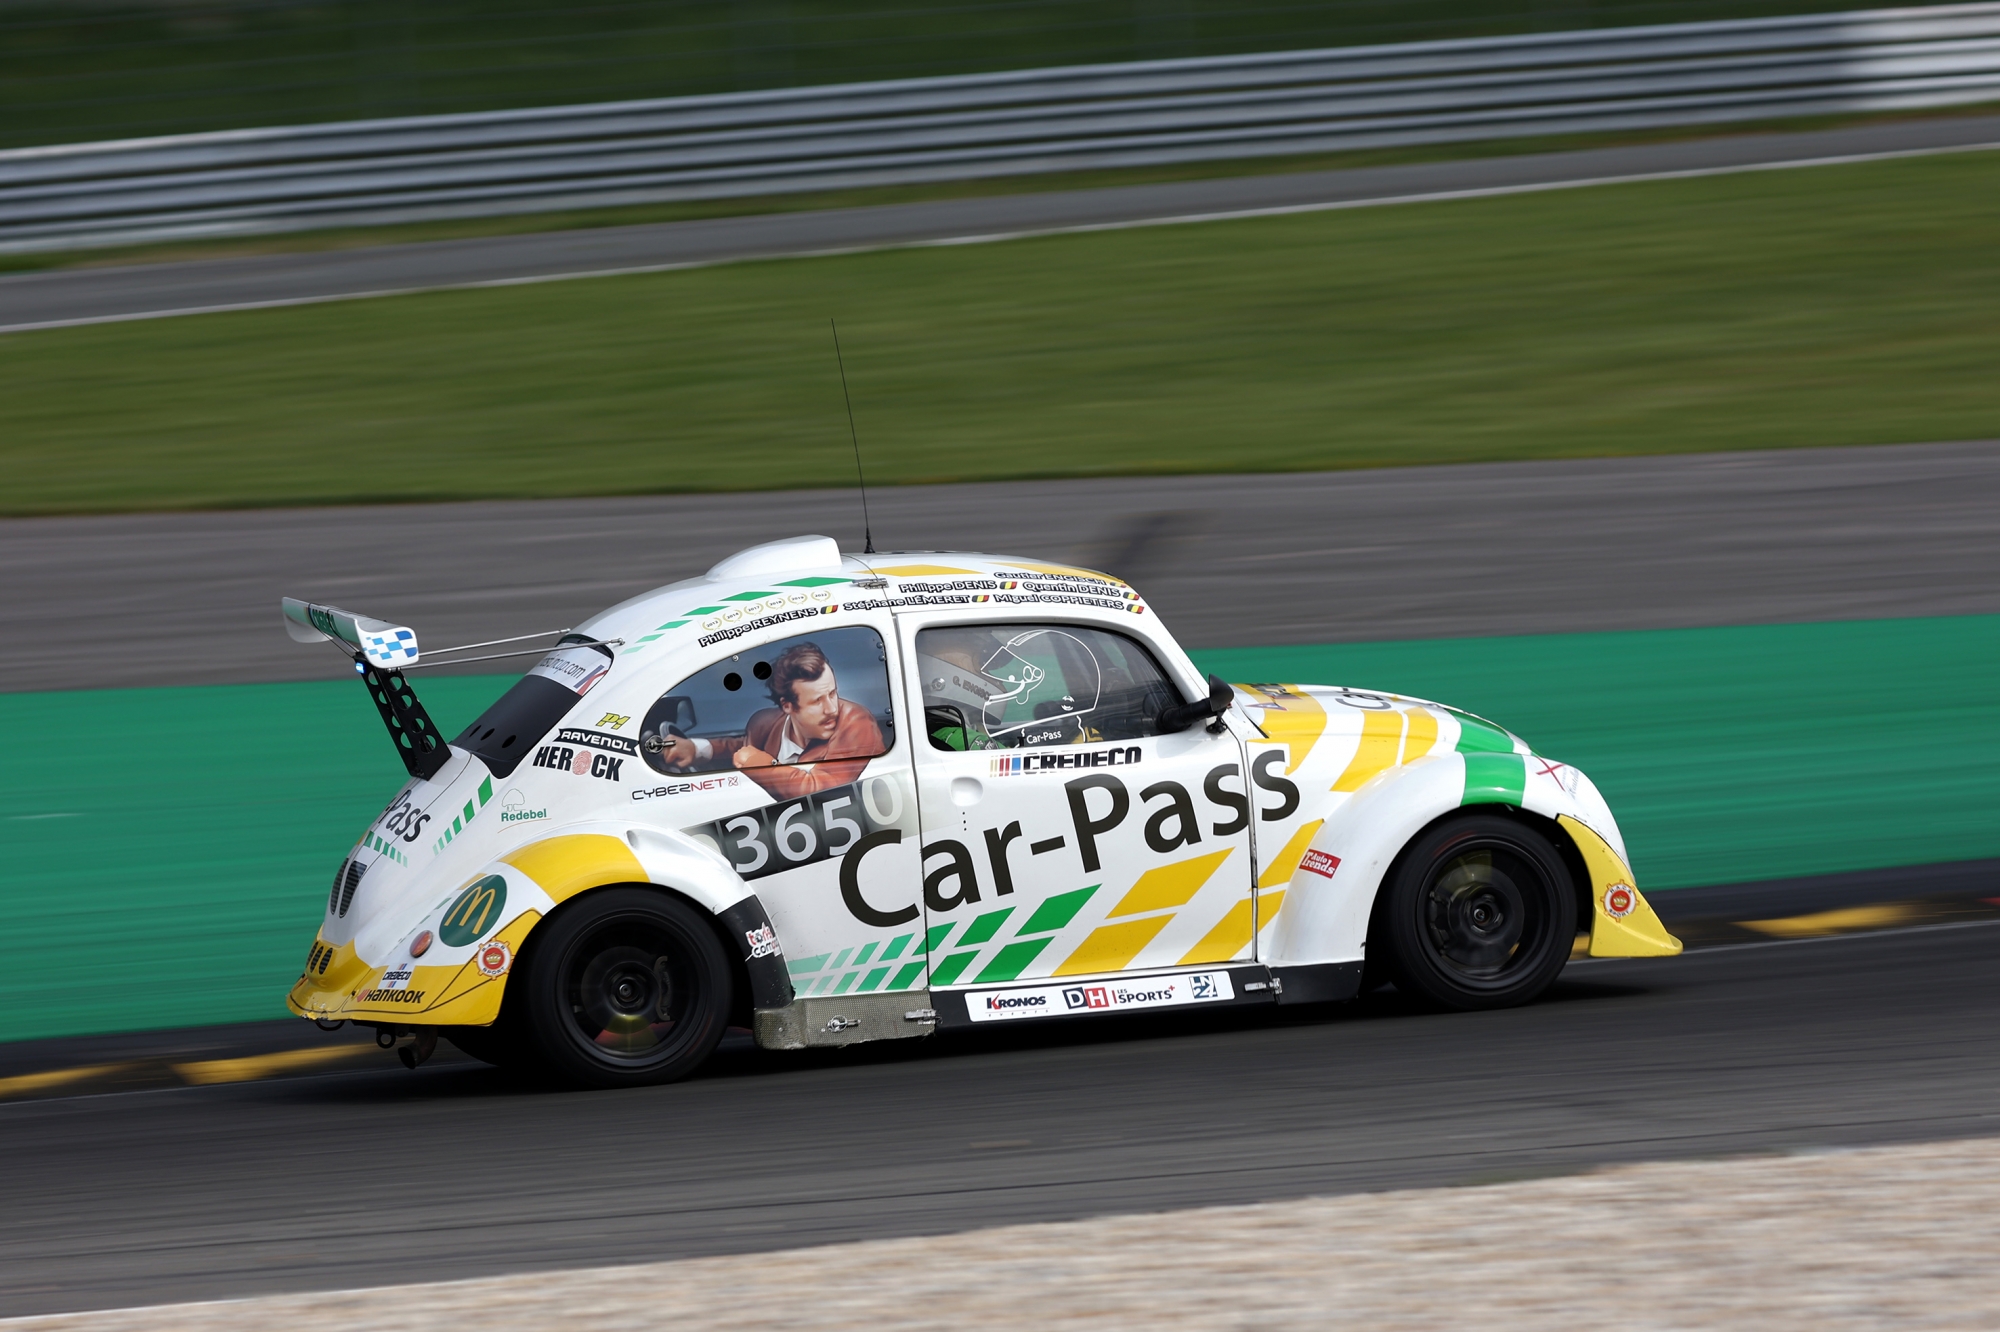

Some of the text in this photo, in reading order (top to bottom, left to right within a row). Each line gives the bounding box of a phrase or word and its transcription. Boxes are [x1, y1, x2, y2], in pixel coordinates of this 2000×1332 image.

[898, 580, 998, 594] Philippe DENIS
[993, 571, 1107, 586] Gautier ENGISCH
[1022, 582, 1121, 598] Quentin DENIS
[843, 594, 970, 611] Stéphane LÉMERET
[992, 594, 1125, 611] Miguel COPPIETERS
[698, 607, 819, 648] Philippe REYNENS
[560, 730, 632, 752] RAVENOL
[1026, 731, 1062, 745] Car-Pass
[1023, 746, 1142, 774] CREDECO
[631, 777, 726, 801] CYBERNET
[501, 808, 548, 823] Redebel
[838, 748, 1301, 927] Car-Pass
[1301, 851, 1336, 875] Trends
[1312, 853, 1328, 863] Auto
[382, 971, 412, 981] CREDECO
[986, 993, 1047, 1010] KRONOS
[1063, 987, 1109, 1009] DH
